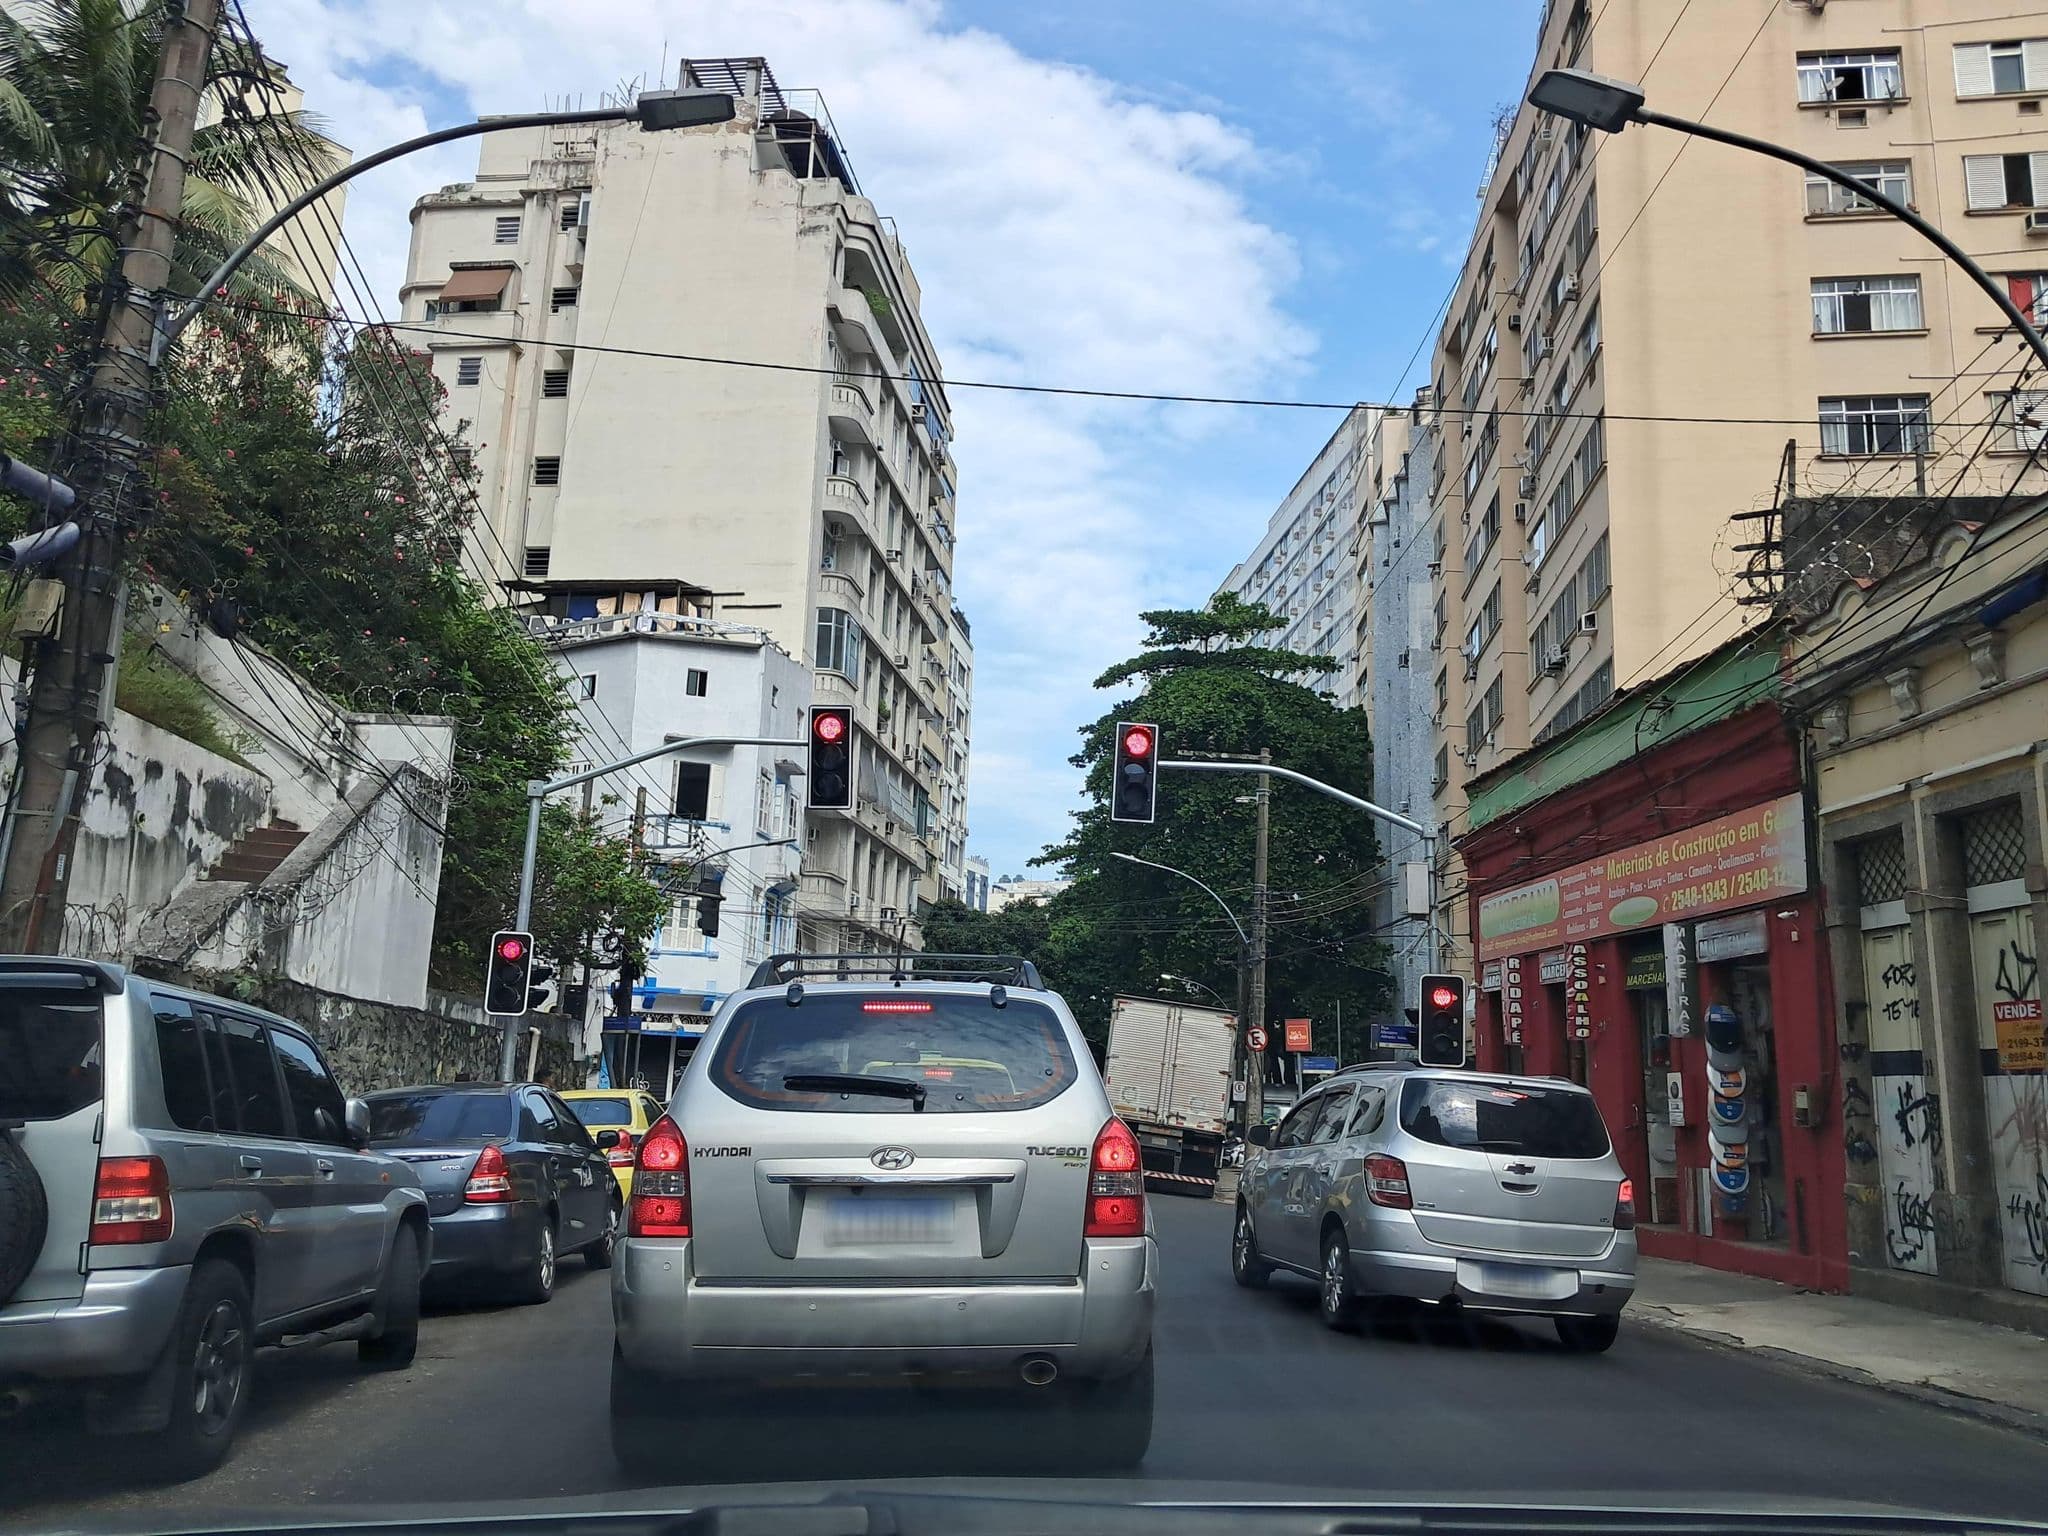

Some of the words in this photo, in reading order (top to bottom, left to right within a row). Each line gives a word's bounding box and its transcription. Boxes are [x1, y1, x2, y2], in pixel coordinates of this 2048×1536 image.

[1607, 851, 1653, 881] Materiais
[1656, 844, 1669, 867] de
[1672, 826, 1736, 862] Construção
[1740, 822, 1759, 842] em
[1508, 957, 1522, 1043] RODAPÉ
[1573, 944, 1590, 1038] ASSOALHO
[1674, 927, 1690, 1034] MADEIRAS
[694, 1147, 752, 1158] HYUNDAI
[1026, 1146, 1088, 1156] TUCSON
